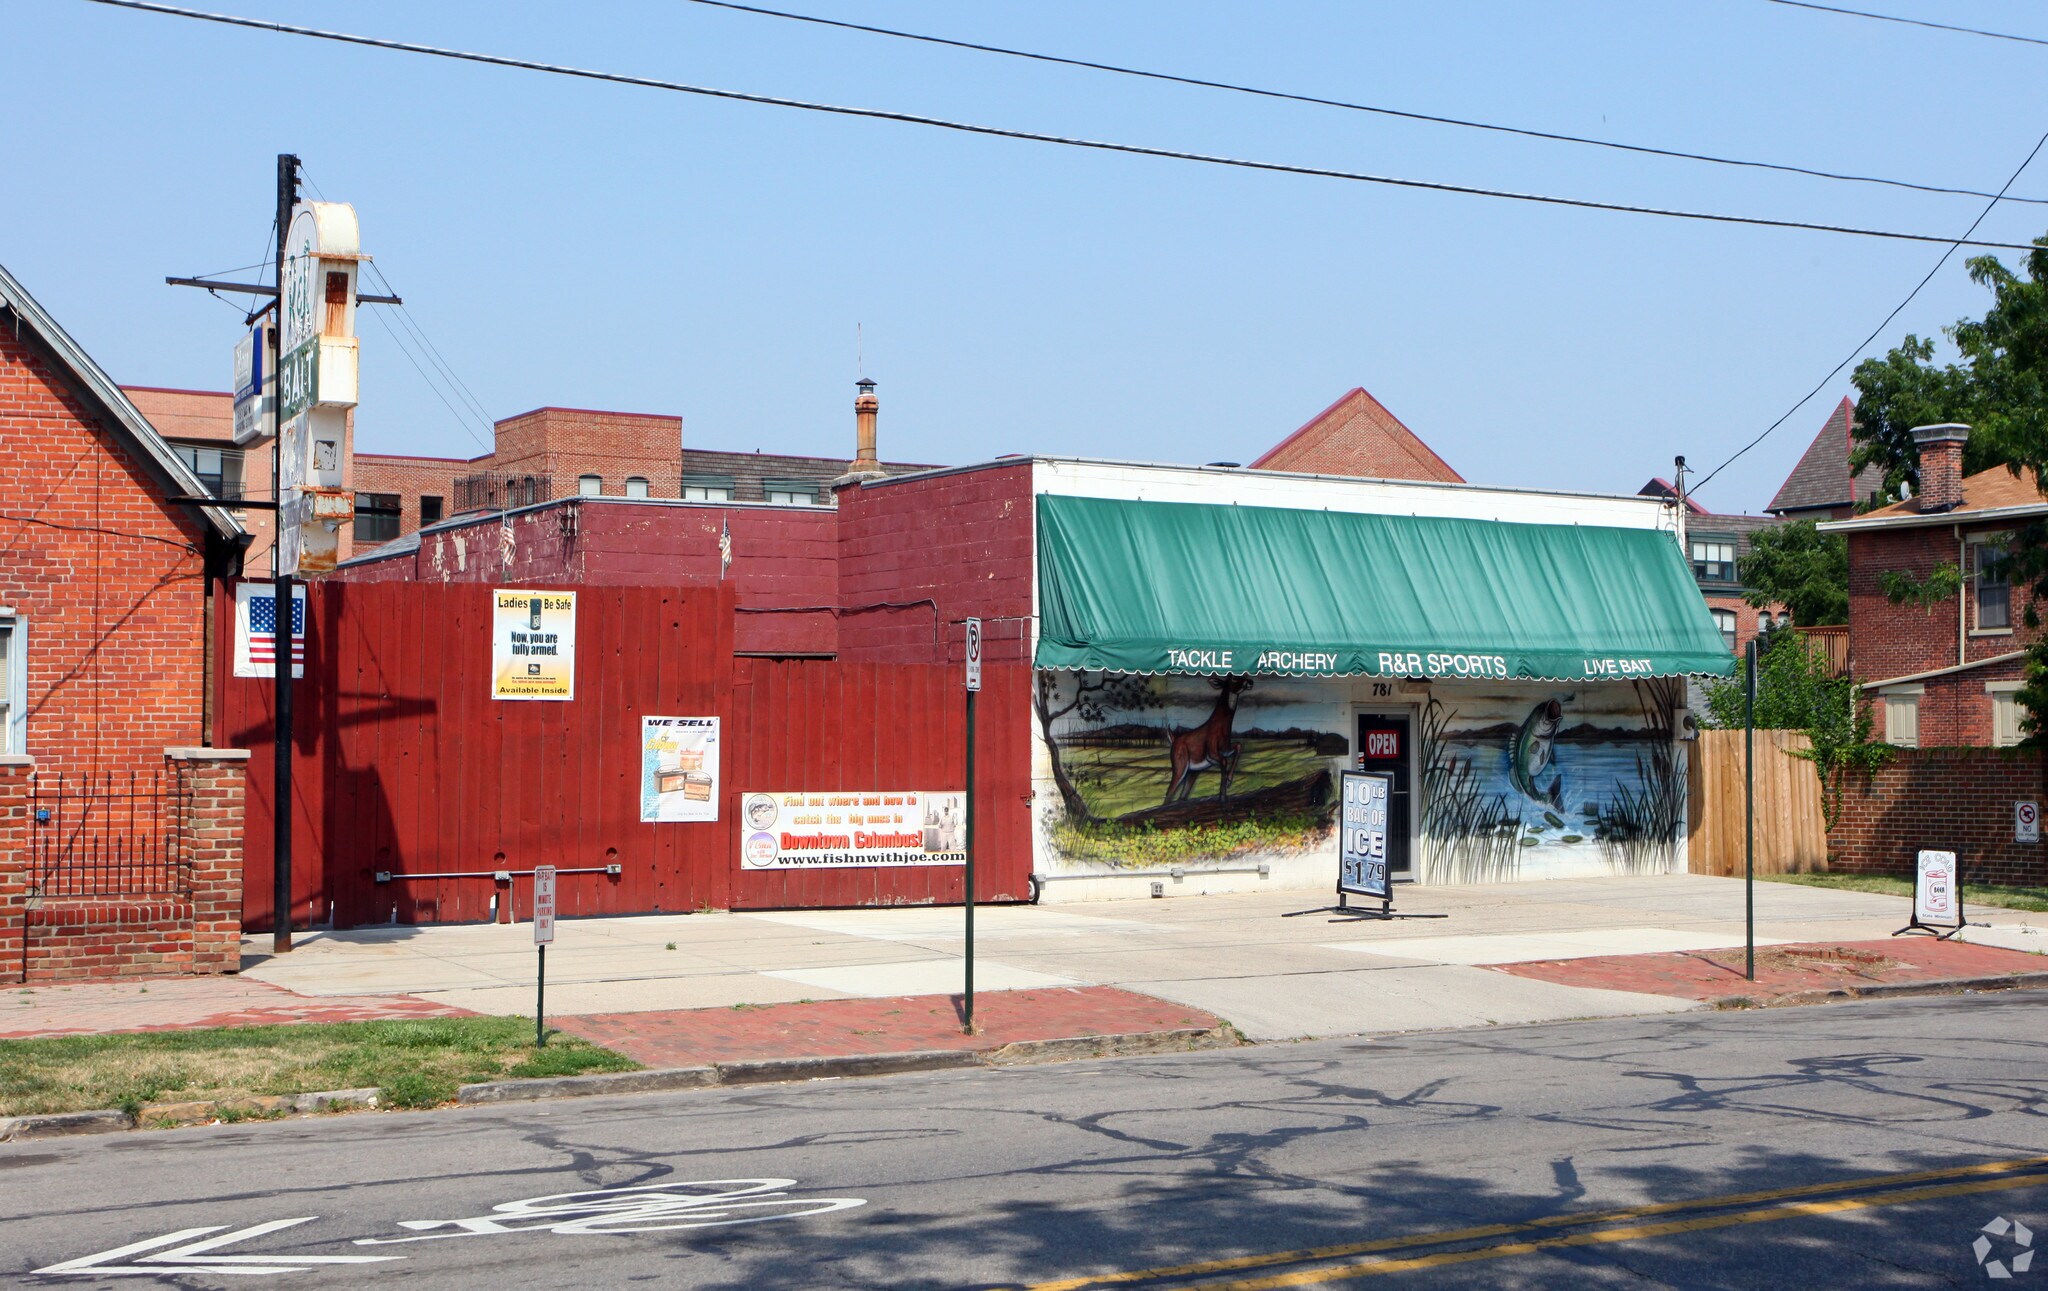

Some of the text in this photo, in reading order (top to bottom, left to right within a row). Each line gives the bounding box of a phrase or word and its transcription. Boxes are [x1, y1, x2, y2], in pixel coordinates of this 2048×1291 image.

[283, 350, 314, 408] BAIT
[498, 596, 572, 610] Ladies Be Safe
[511, 631, 558, 645] Now, you are
[512, 643, 559, 656] fully armed.
[1168, 650, 1653, 676] TACKLE ARCHERY R&R SPORTS LIVE BAIT
[500, 686, 539, 694] Available
[1372, 683, 1392, 697] 781
[677, 719, 714, 727] SELL
[1369, 733, 1397, 755] OPEN
[1345, 781, 1385, 805] 10 LB
[783, 794, 917, 807] Find out where and how to
[793, 813, 903, 826] catch the big ones in
[1347, 807, 1385, 826] BAG OF
[781, 830, 924, 850] Downtown Columbus!
[1347, 827, 1384, 858] ICE
[778, 852, 966, 865] www.fishnwithjoe.com
[1345, 860, 1386, 887] $1.79
